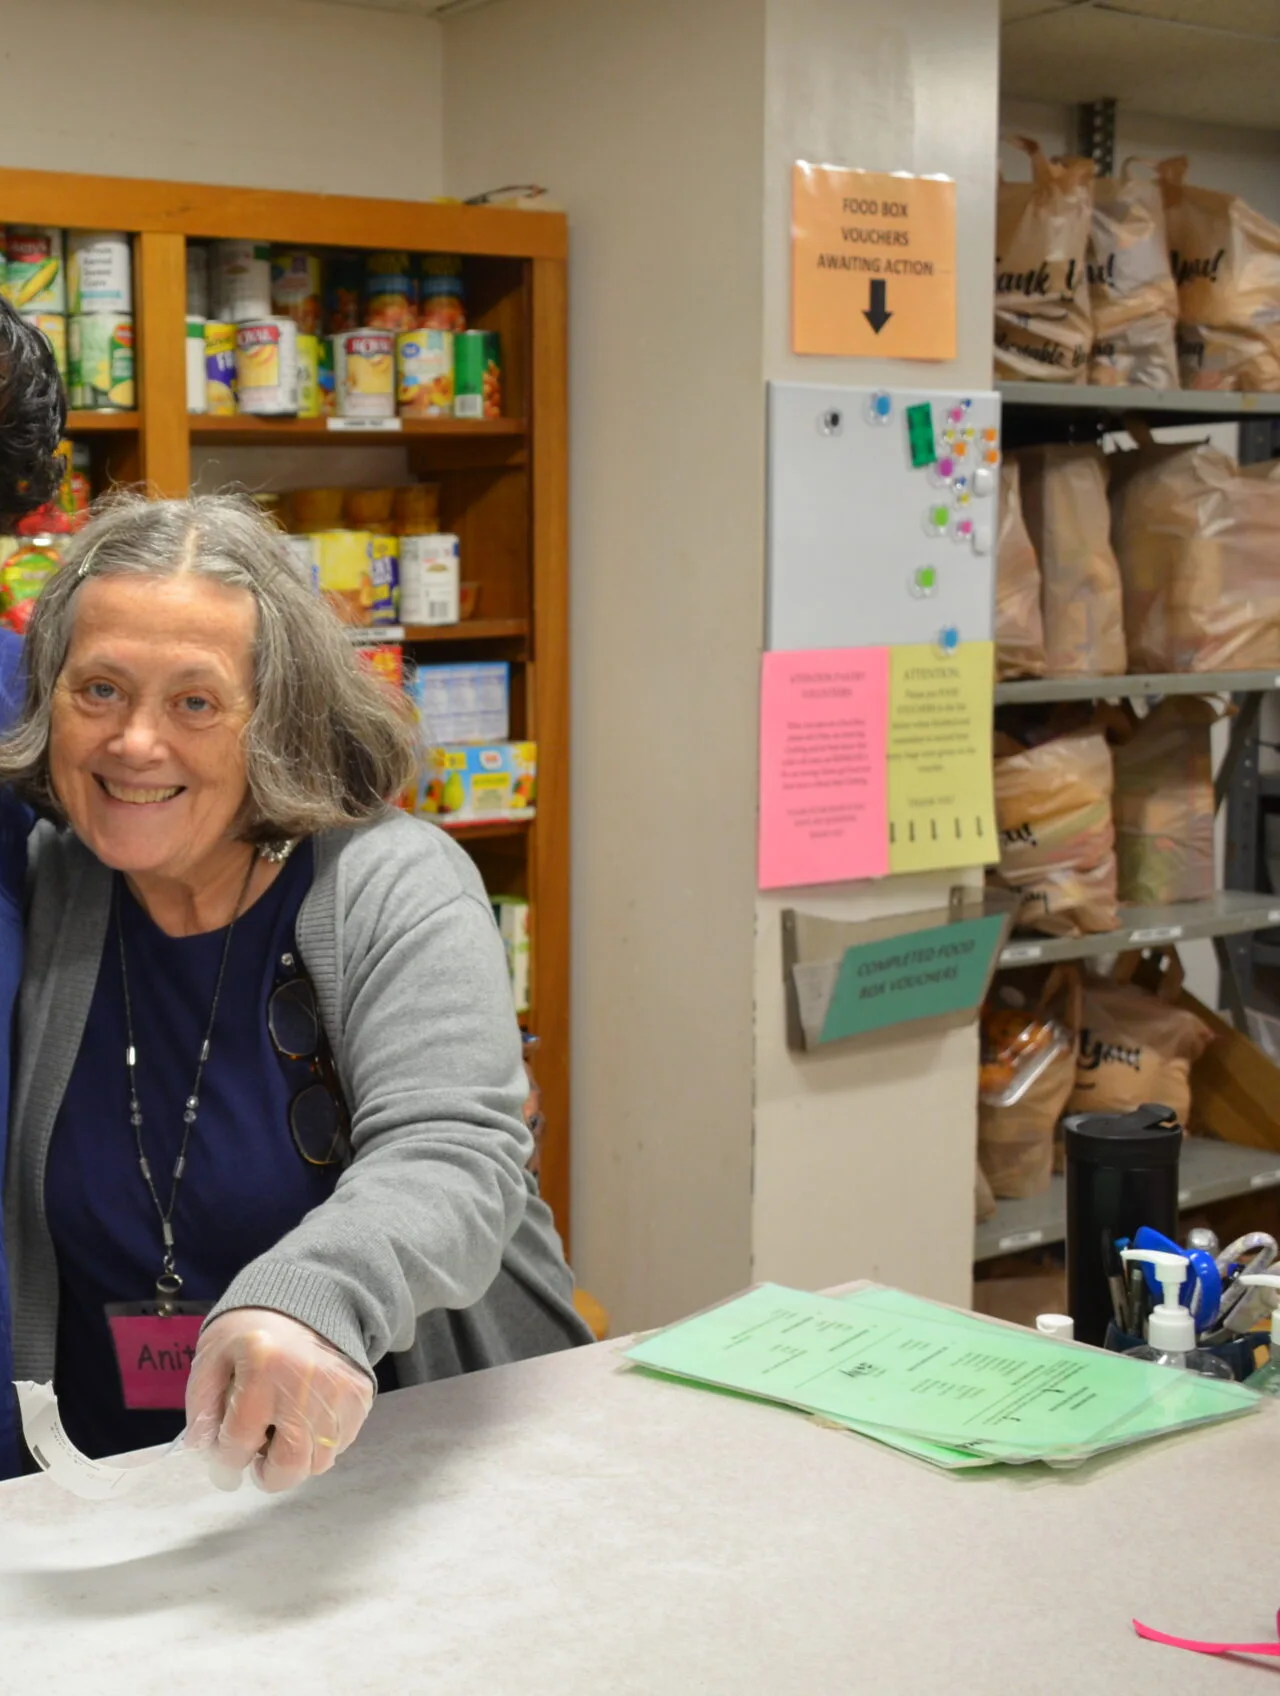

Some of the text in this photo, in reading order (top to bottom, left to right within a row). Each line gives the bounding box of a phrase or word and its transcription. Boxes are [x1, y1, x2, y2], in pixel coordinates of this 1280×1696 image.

[842, 199, 909, 217] FOOD BOX
[841, 227, 910, 247] VOUCHERS
[817, 253, 934, 276] AWAITING ACTION
[857, 946, 936, 978] COMPLETED
[936, 938, 976, 960] FOOD
[858, 964, 960, 999] BOX VOUCHERS
[137, 1343, 195, 1372] Anit
